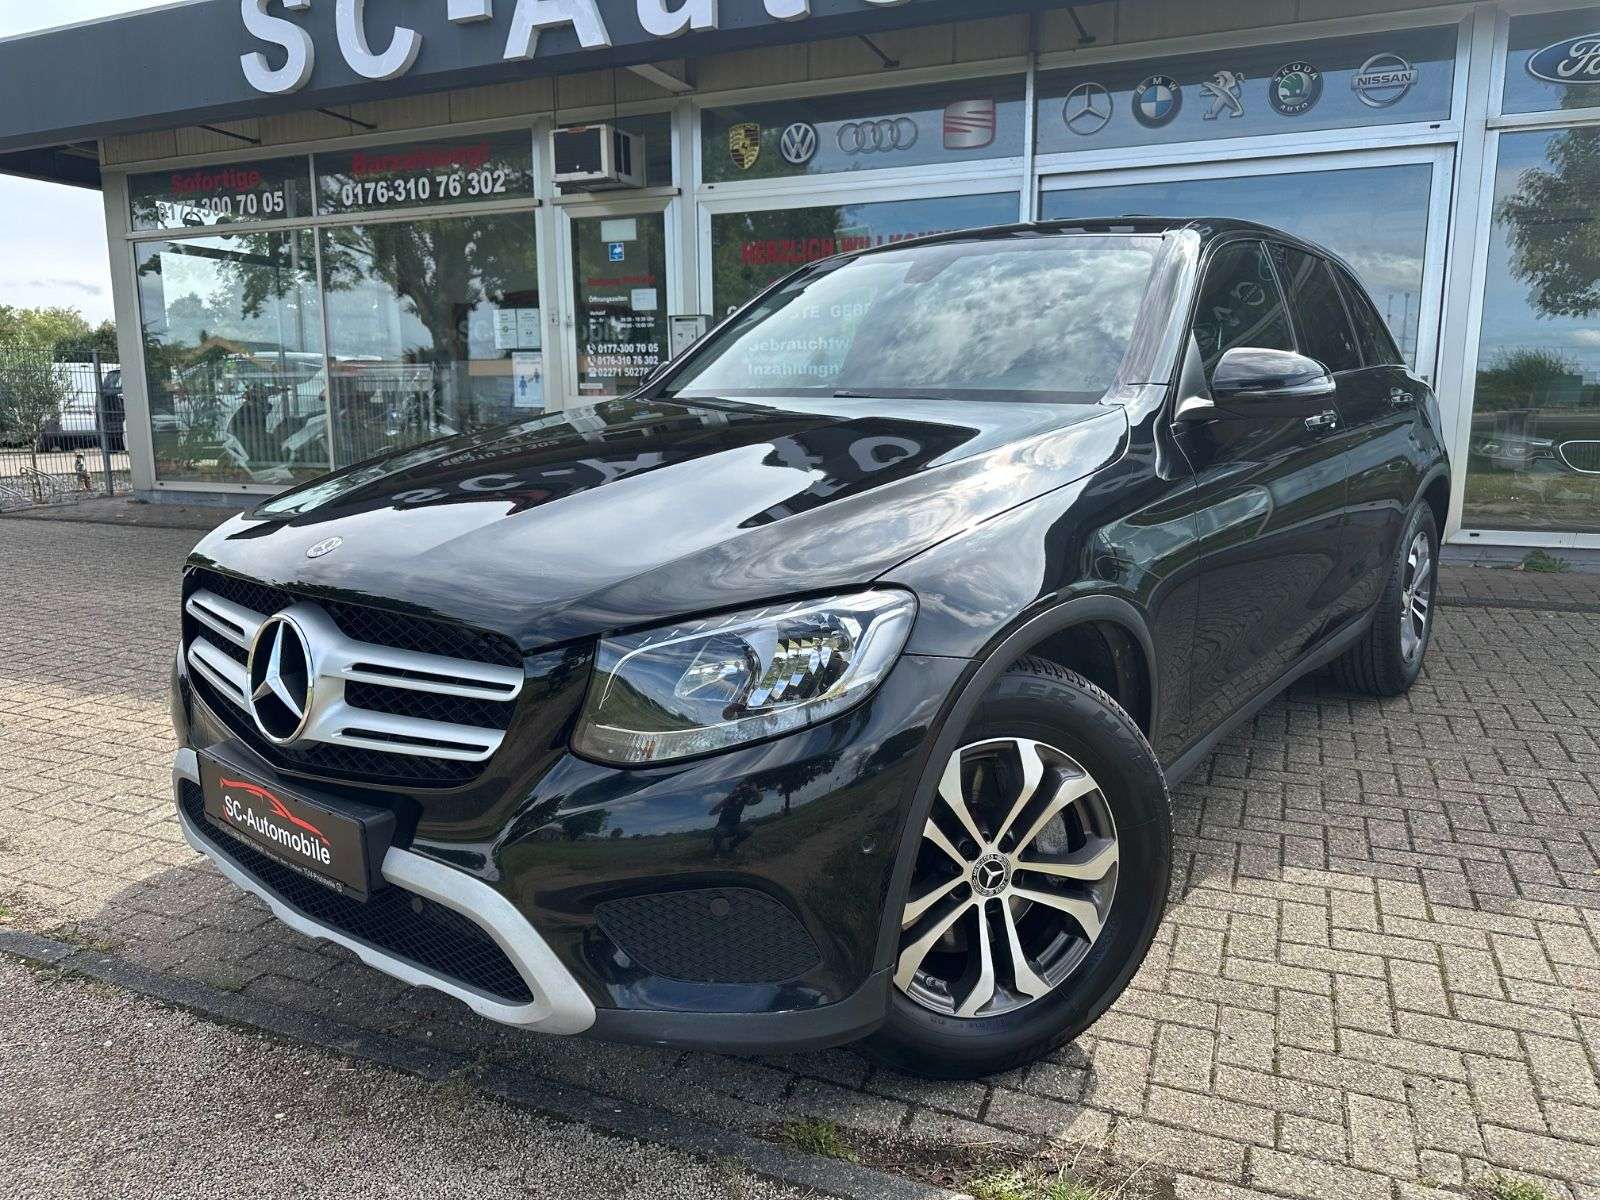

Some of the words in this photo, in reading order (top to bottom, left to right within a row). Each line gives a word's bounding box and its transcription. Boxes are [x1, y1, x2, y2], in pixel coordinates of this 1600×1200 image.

[1137, 77, 1178, 95] BMW
[1357, 72, 1412, 86] NISSAN
[1279, 102, 1309, 112] AUTO
[172, 168, 262, 193] Sofortige
[342, 177, 430, 206] 0176-310
[436, 174, 461, 198] 76
[467, 170, 506, 196] 302
[236, 193, 258, 215] 70
[263, 190, 284, 213] 05
[598, 344, 634, 353] 0177-300
[636, 343, 646, 353] 70
[648, 343, 659, 352] 05
[644, 355, 659, 365] 302
[223, 794, 332, 866] SC-Automobile
